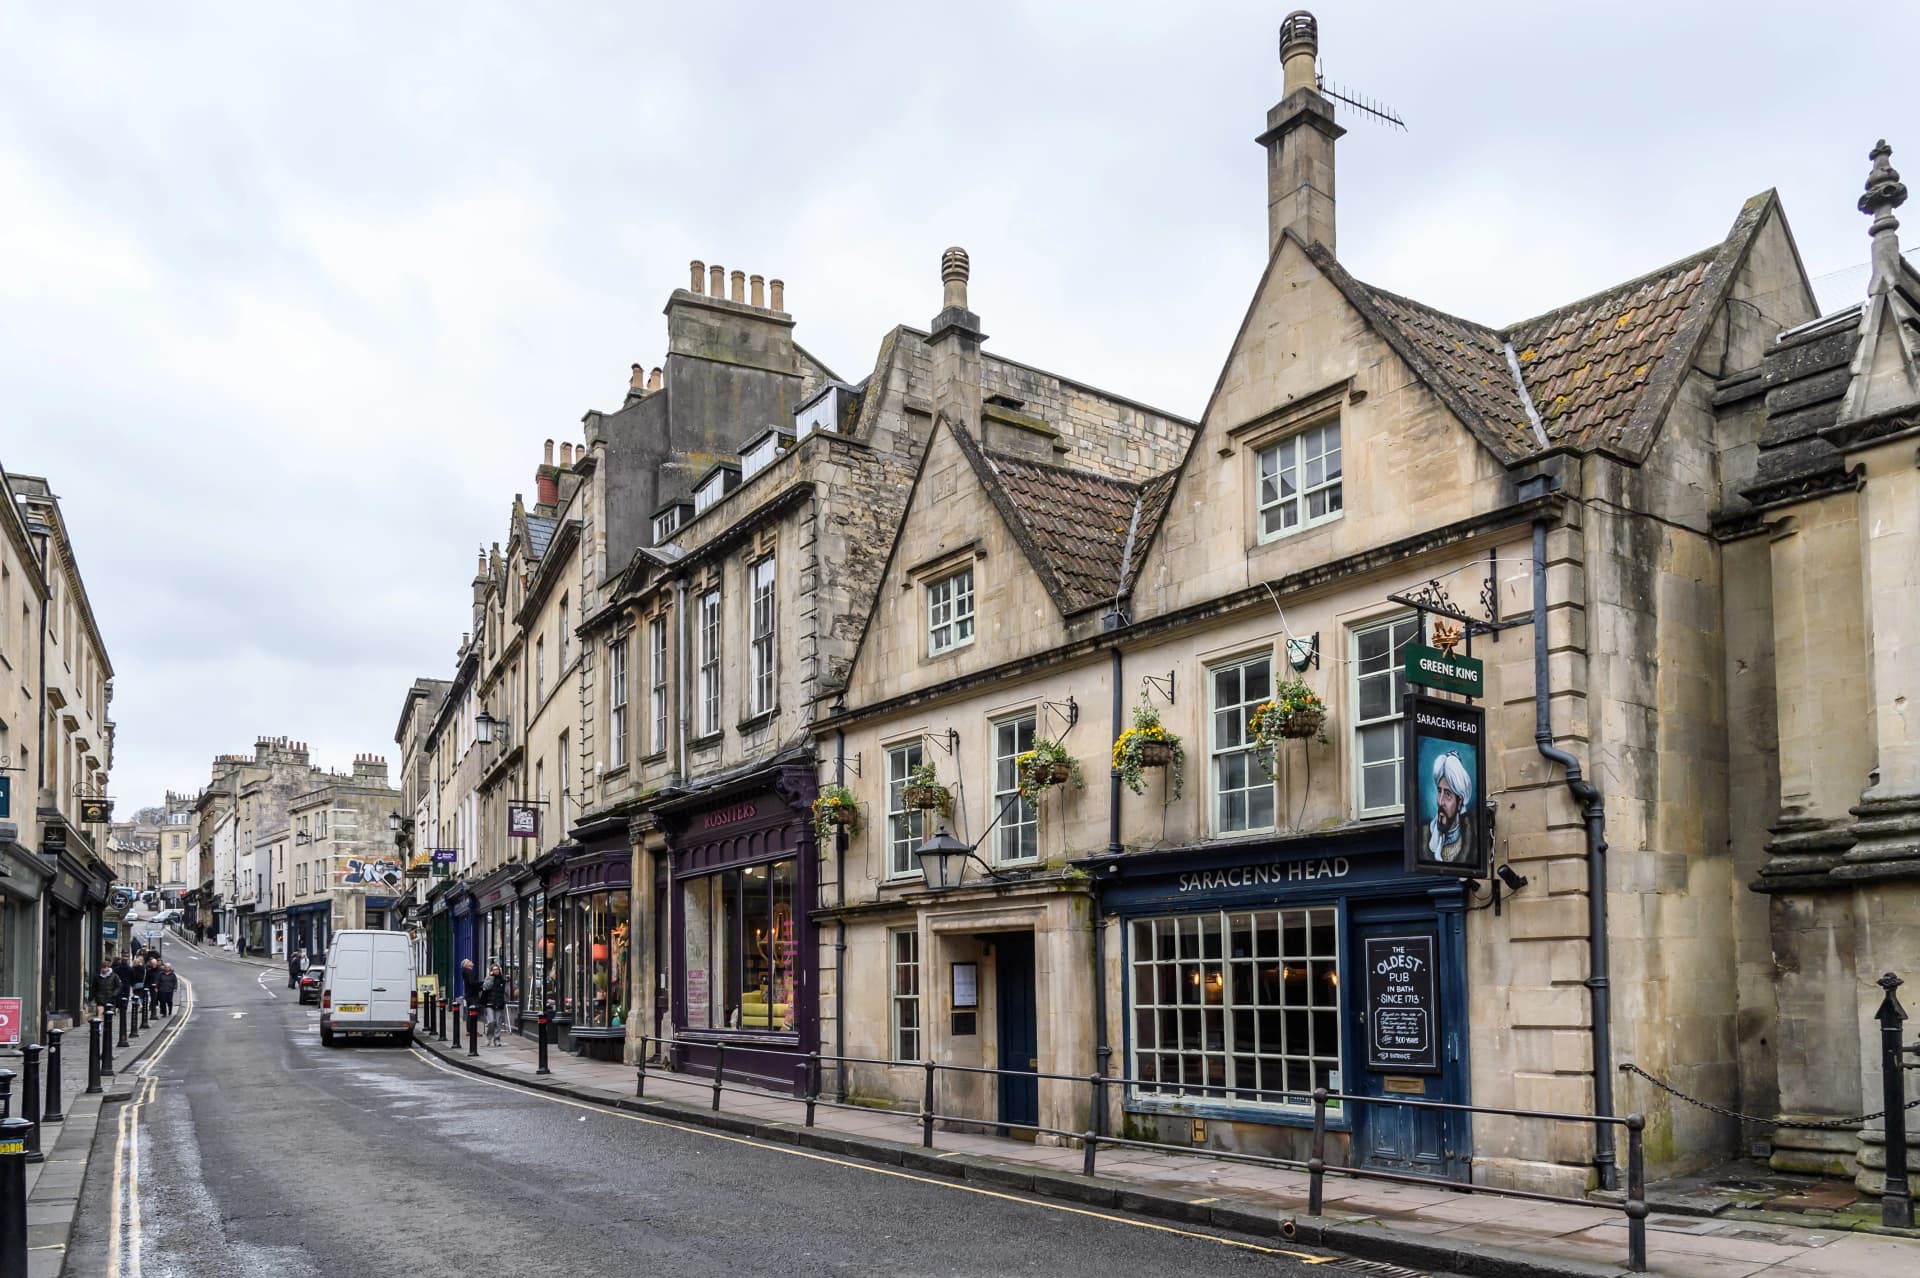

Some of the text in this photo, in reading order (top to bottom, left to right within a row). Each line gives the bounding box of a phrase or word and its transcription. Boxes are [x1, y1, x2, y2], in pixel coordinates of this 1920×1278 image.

[1420, 658, 1454, 677] GREENE
[1456, 666, 1478, 682] KING
[1417, 713, 1477, 734] SARACENS HEAD
[704, 801, 756, 829] ROSSITERS
[1179, 857, 1349, 892] SARACENS HEAD
[1392, 946, 1405, 954] THE
[1377, 955, 1423, 975] OLDEST
[1389, 972, 1410, 983] PUB
[1380, 993, 1420, 1004] SINCE 1713
[1387, 985, 1414, 993] IN BATH
[1193, 1119, 1206, 1140] H
